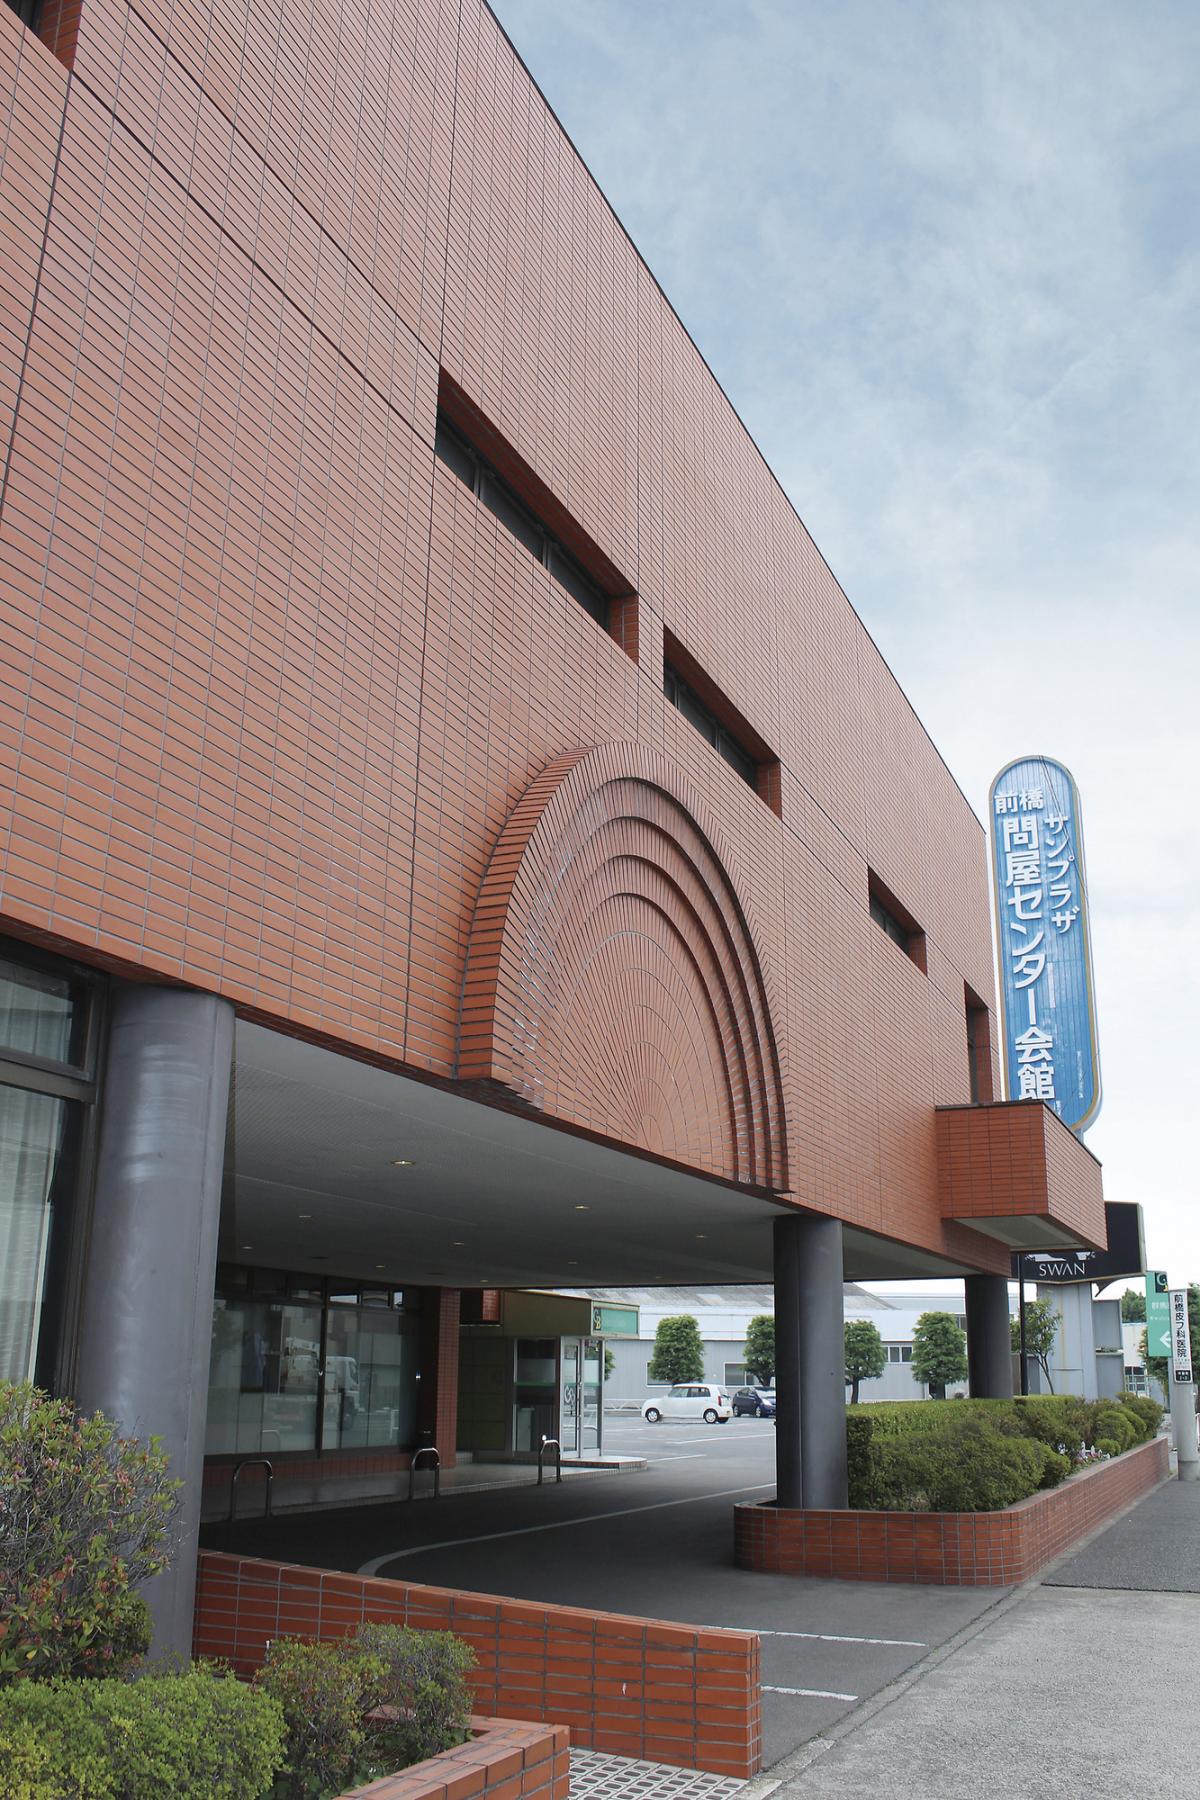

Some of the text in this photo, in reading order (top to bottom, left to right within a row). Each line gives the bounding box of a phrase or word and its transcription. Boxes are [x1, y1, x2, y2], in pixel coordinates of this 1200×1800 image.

[994, 788, 1043, 814] 前橋
[1044, 814, 1080, 934] サンプラザ
[1003, 815, 1055, 1100] 問屋センター会館
[1039, 1262, 1085, 1276] SWAN
[1174, 1294, 1187, 1357] 前橋皮フ科医院
